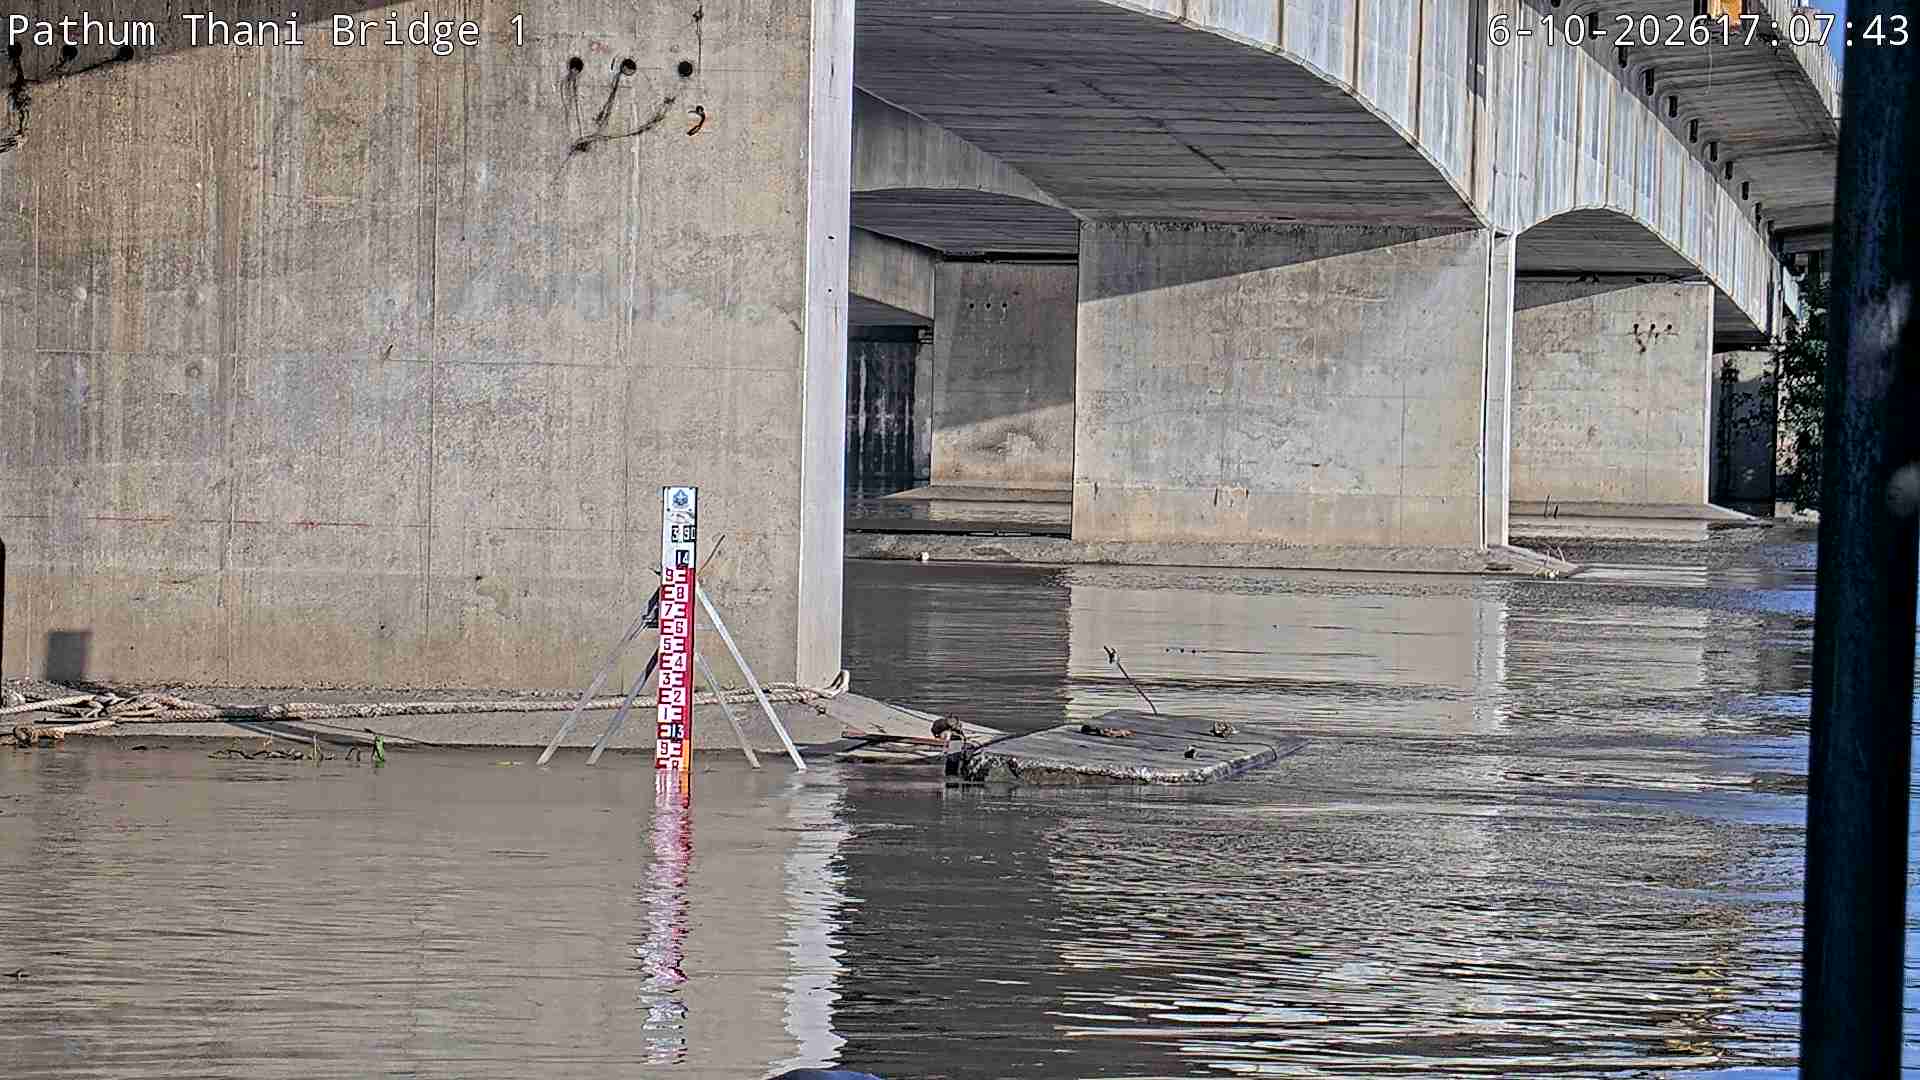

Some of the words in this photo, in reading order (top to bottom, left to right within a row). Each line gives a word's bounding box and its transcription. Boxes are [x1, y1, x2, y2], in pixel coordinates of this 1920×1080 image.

[677, 551, 689, 564] 14
[665, 567, 674, 582] 9
[676, 586, 685, 599] 8
[664, 603, 673, 617] 7
[675, 621, 684, 634] 6
[663, 637, 672, 651] 5
[674, 655, 683, 668] 4
[662, 672, 671, 685] 3
[673, 690, 682, 703] 2
[672, 724, 685, 738] 13
[660, 741, 669, 755] 9
